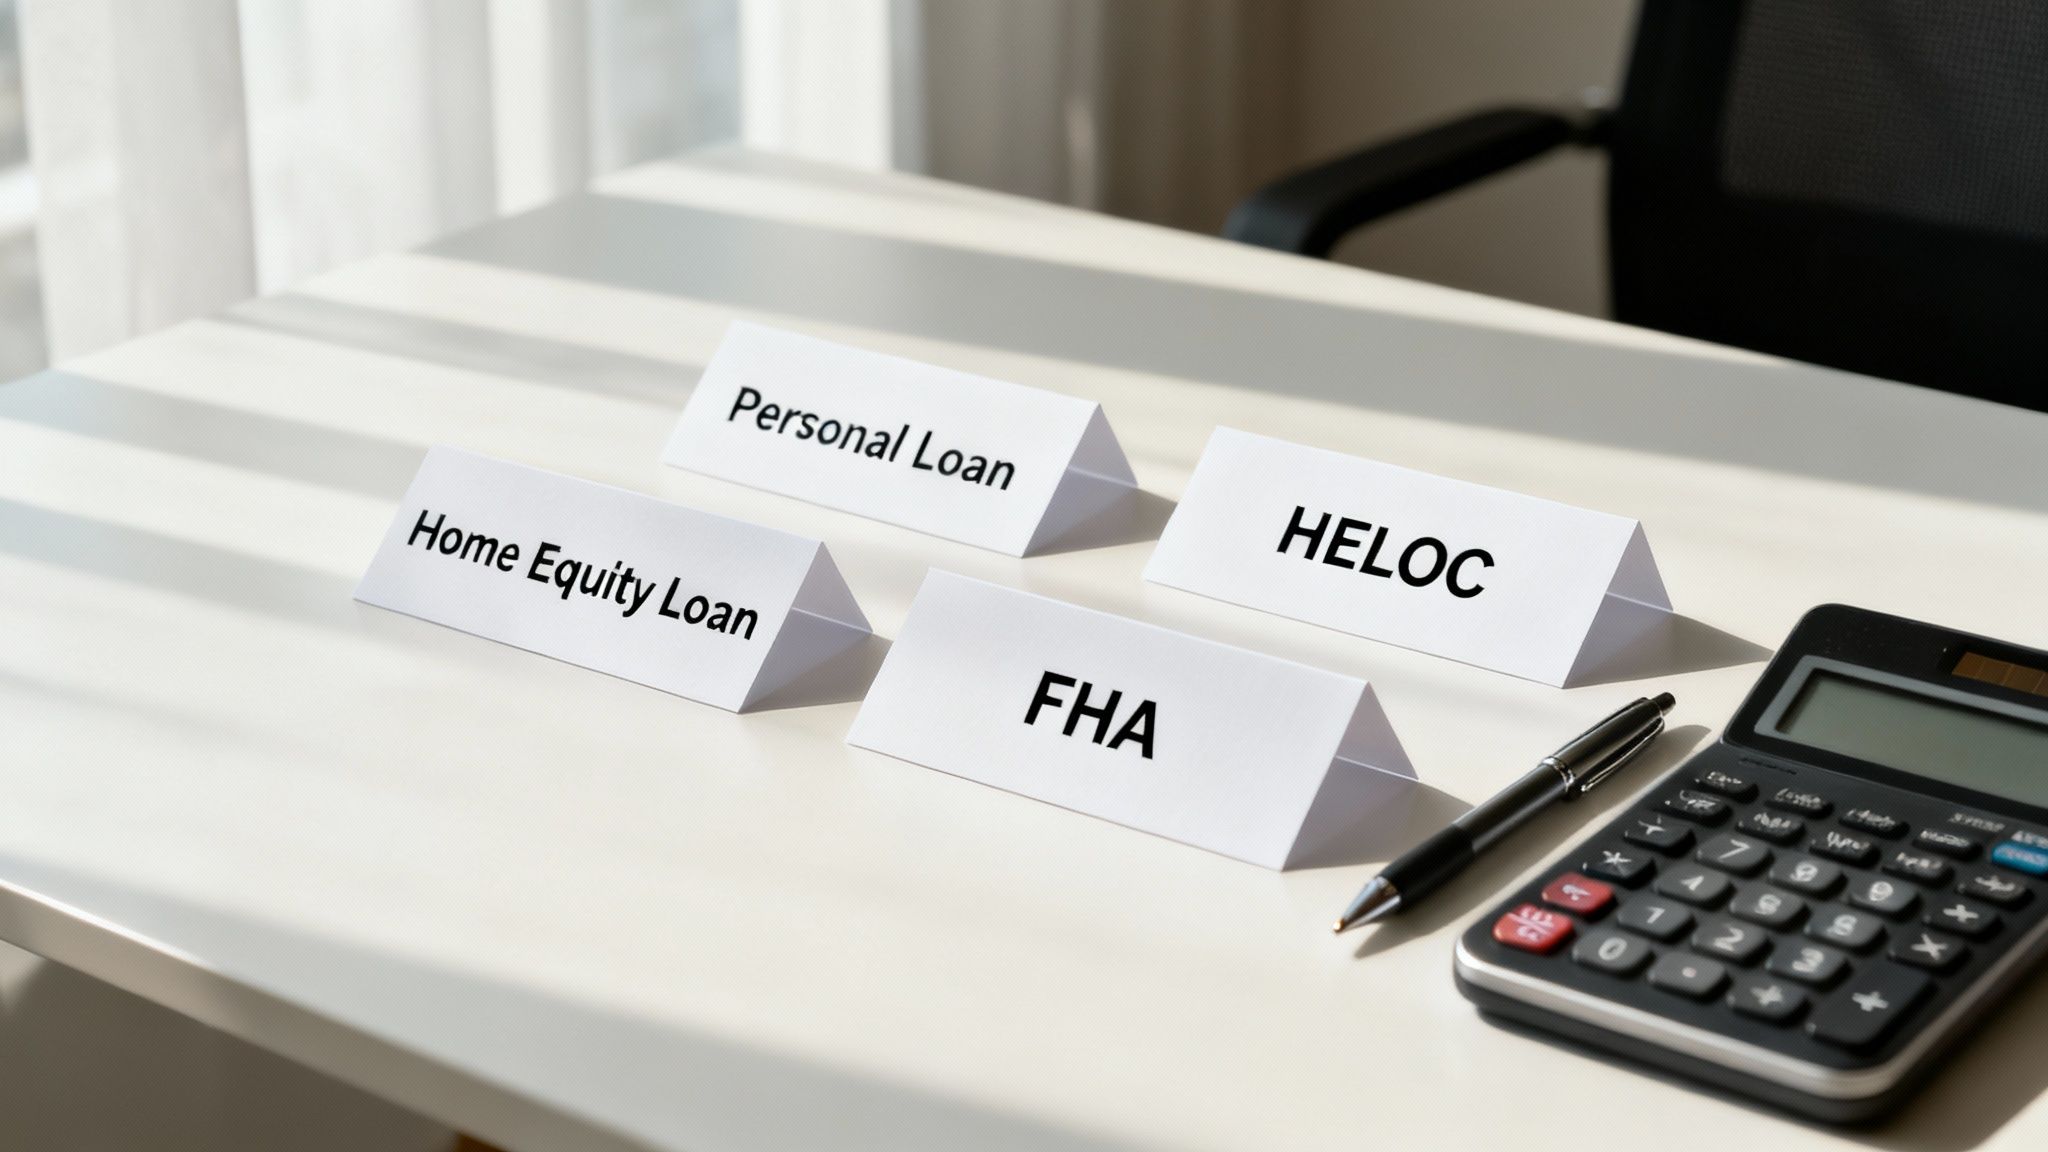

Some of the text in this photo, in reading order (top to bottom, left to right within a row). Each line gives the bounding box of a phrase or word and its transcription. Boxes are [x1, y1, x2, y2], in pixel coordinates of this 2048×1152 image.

[728, 386, 1016, 492] Personal Loan
[407, 509, 759, 642] Home Equity Loan
[1276, 505, 1496, 600] HELOC
[1023, 670, 1157, 760] FHA
[1597, 937, 1628, 961] 0
[1713, 926, 1745, 951] 2
